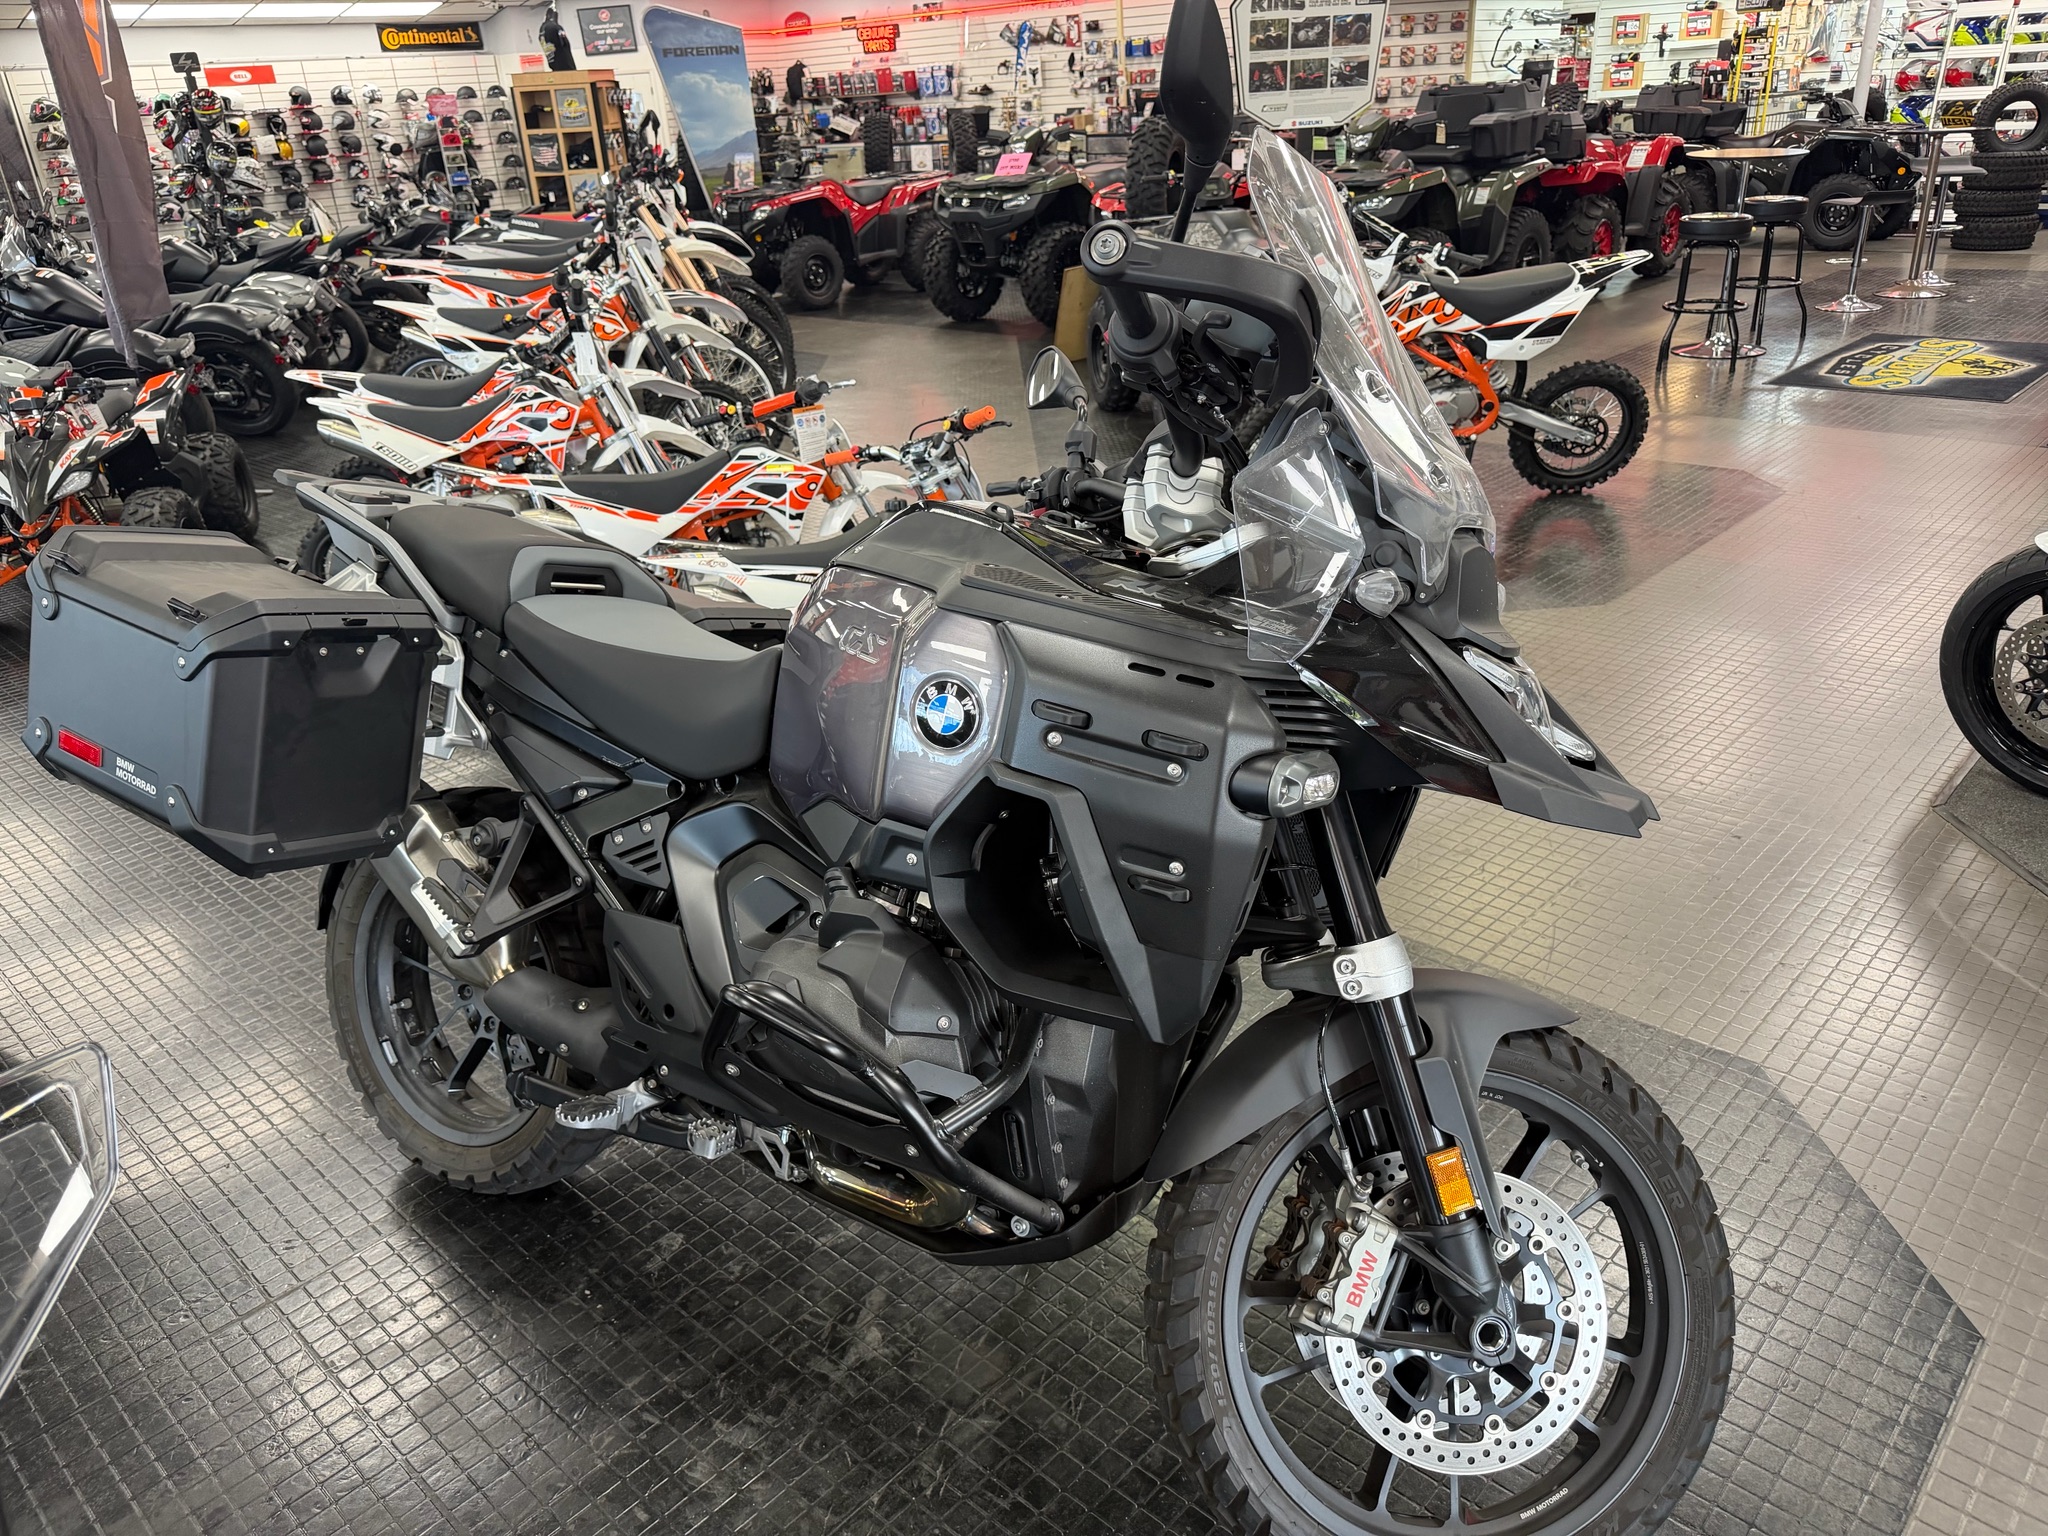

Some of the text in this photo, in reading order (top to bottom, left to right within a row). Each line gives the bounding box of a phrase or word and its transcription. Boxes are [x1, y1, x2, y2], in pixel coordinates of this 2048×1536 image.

[381, 27, 465, 50] Continental
[858, 26, 894, 41] GENUINE
[864, 40, 890, 52] PARTS
[661, 45, 740, 58] FOREMAN
[1833, 344, 1901, 376] CYCLES
[1843, 337, 1978, 388] STUBBS
[794, 574, 816, 583] KM
[838, 624, 889, 665] GS
[926, 682, 975, 714] BMW
[116, 756, 135, 773] BMW
[115, 767, 157, 795] MOTORRAD
[1580, 1088, 1686, 1211] METZELER
[1346, 1250, 1378, 1308] BMW
[1206, 1271, 1226, 1407] 120/70R19
[1519, 1487, 1569, 1520] BMW MOTORRAD
